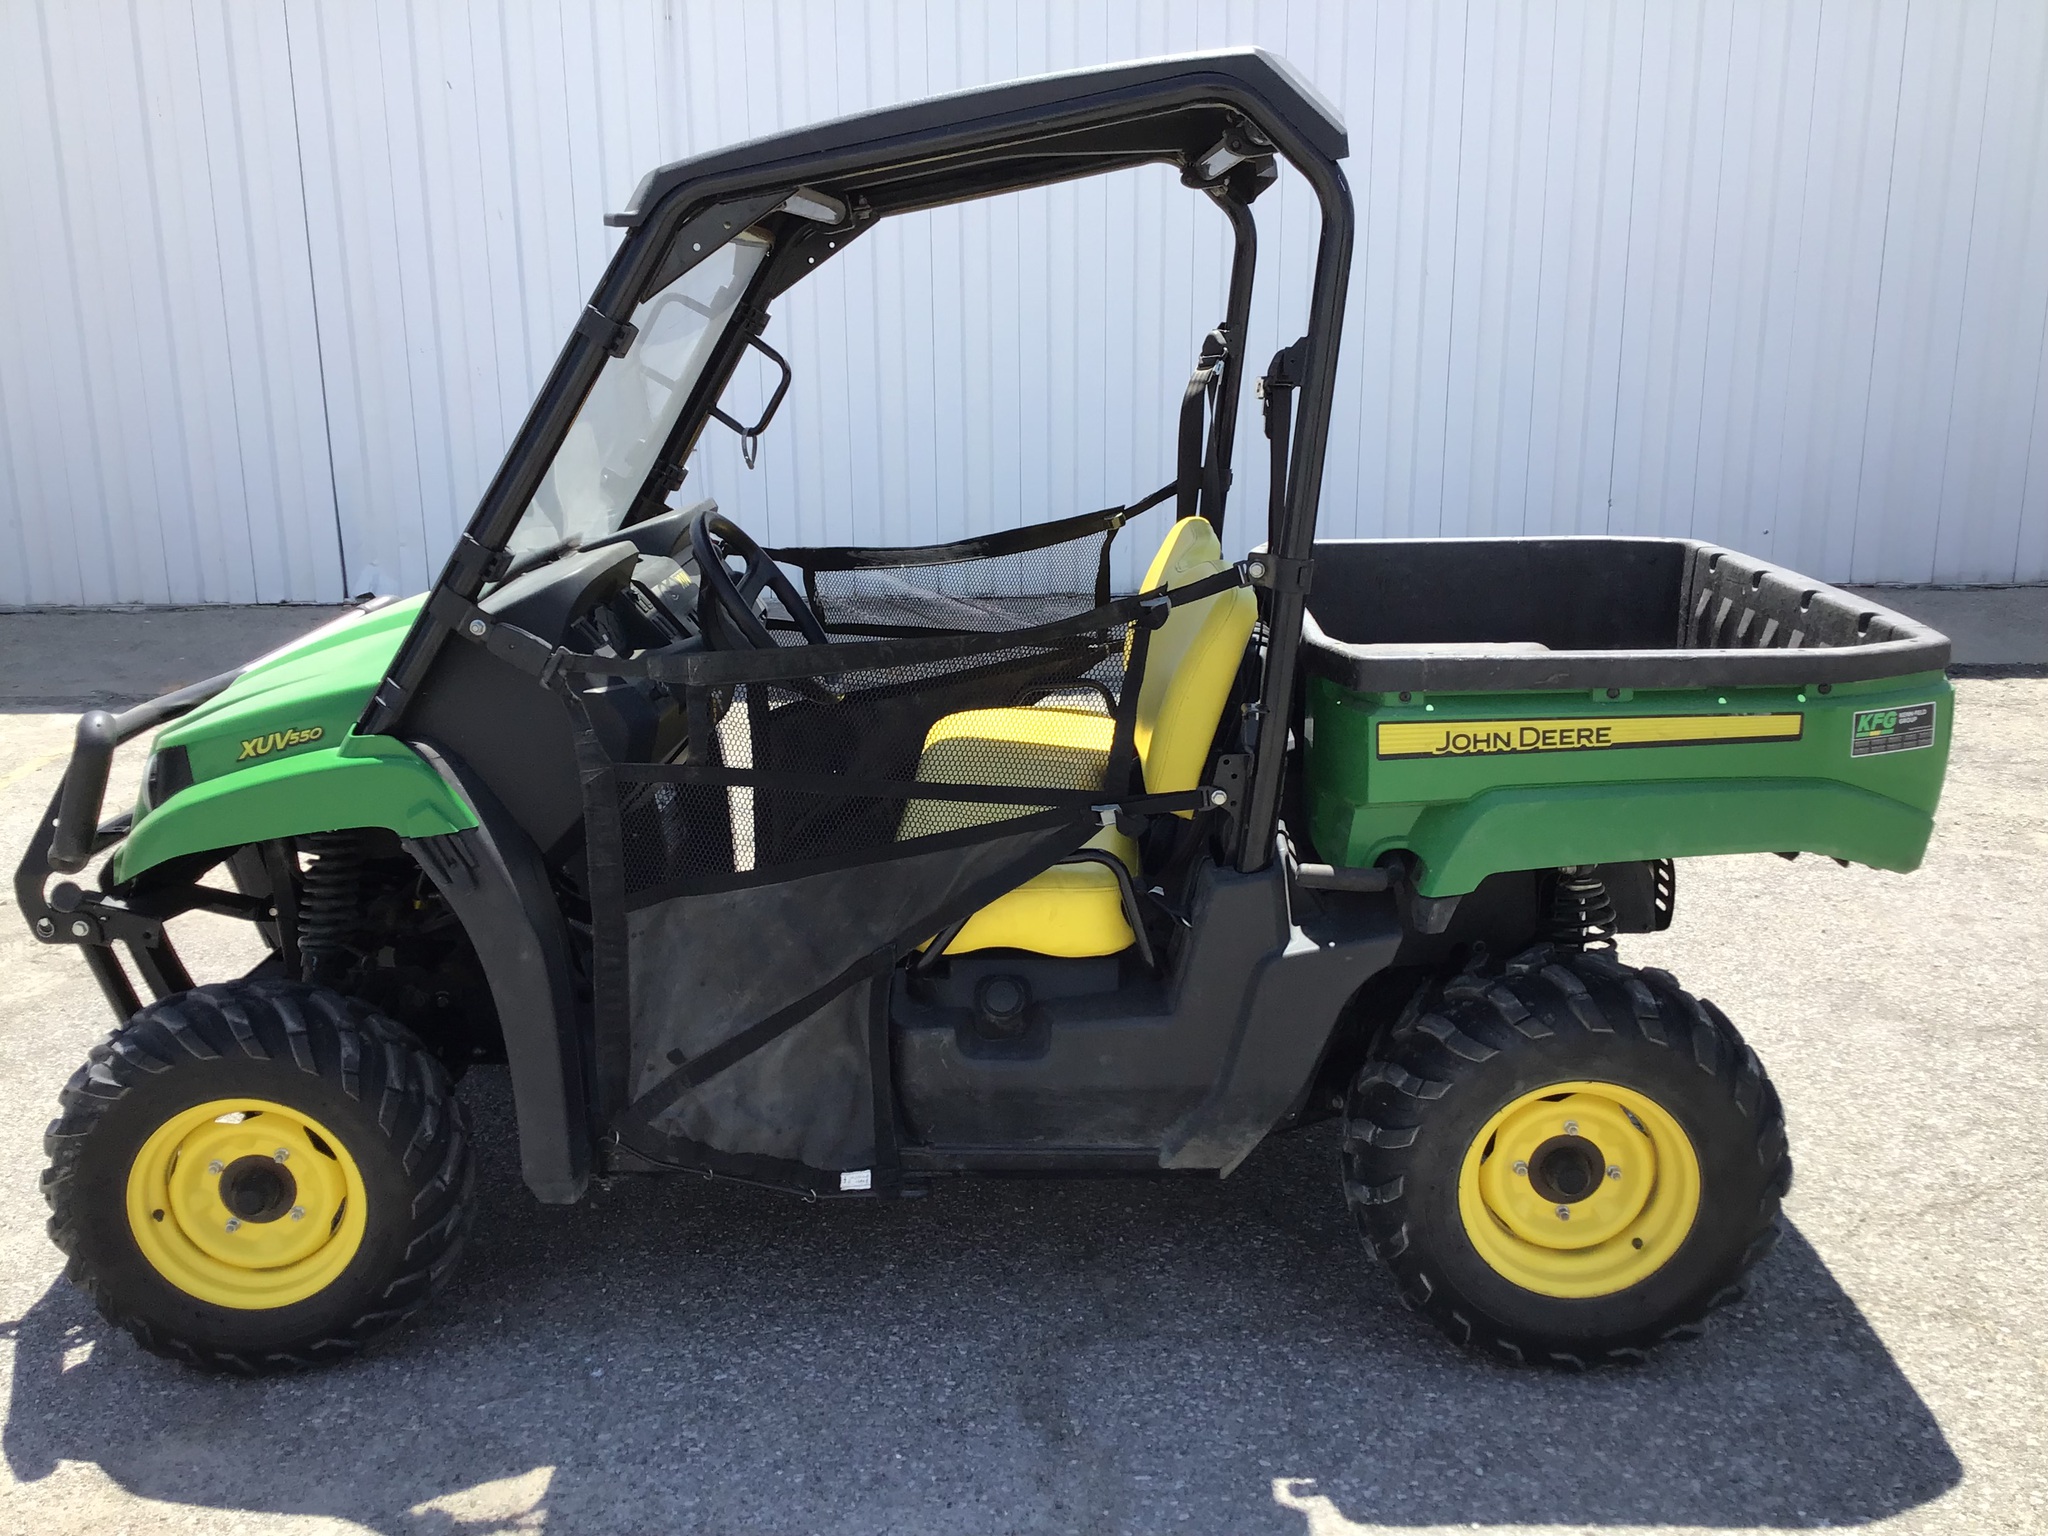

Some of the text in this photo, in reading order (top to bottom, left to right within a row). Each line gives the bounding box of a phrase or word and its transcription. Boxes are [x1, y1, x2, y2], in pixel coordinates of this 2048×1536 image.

[1857, 711, 1897, 732] KFG
[1435, 726, 1612, 752] JOHN DEERE
